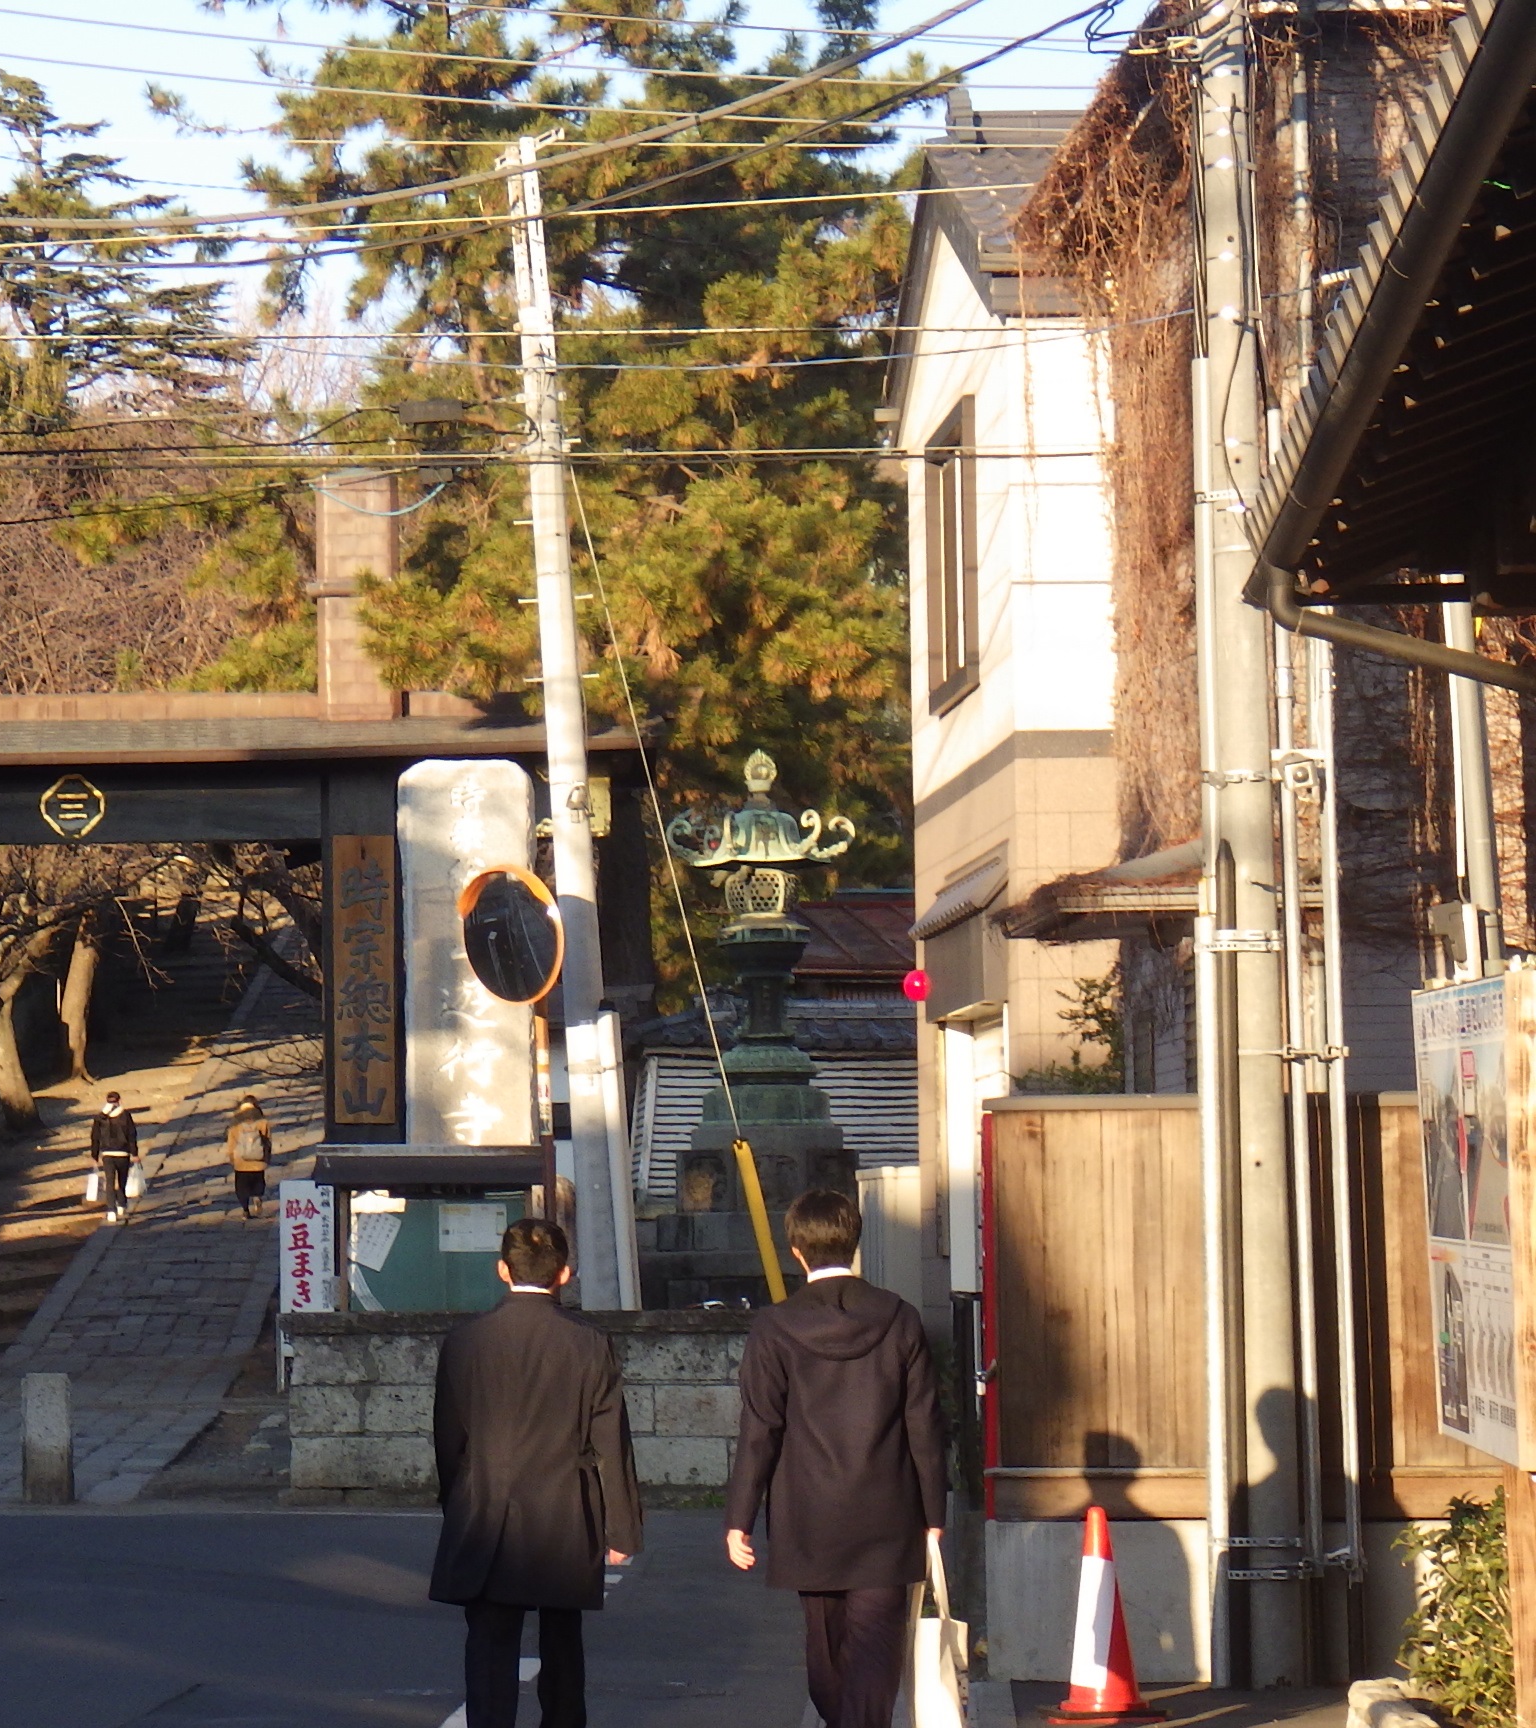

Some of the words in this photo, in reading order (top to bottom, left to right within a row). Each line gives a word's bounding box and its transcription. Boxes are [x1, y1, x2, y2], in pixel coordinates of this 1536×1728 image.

[286, 1199, 321, 1220] 節分
[288, 1223, 315, 1308] 豆まき
